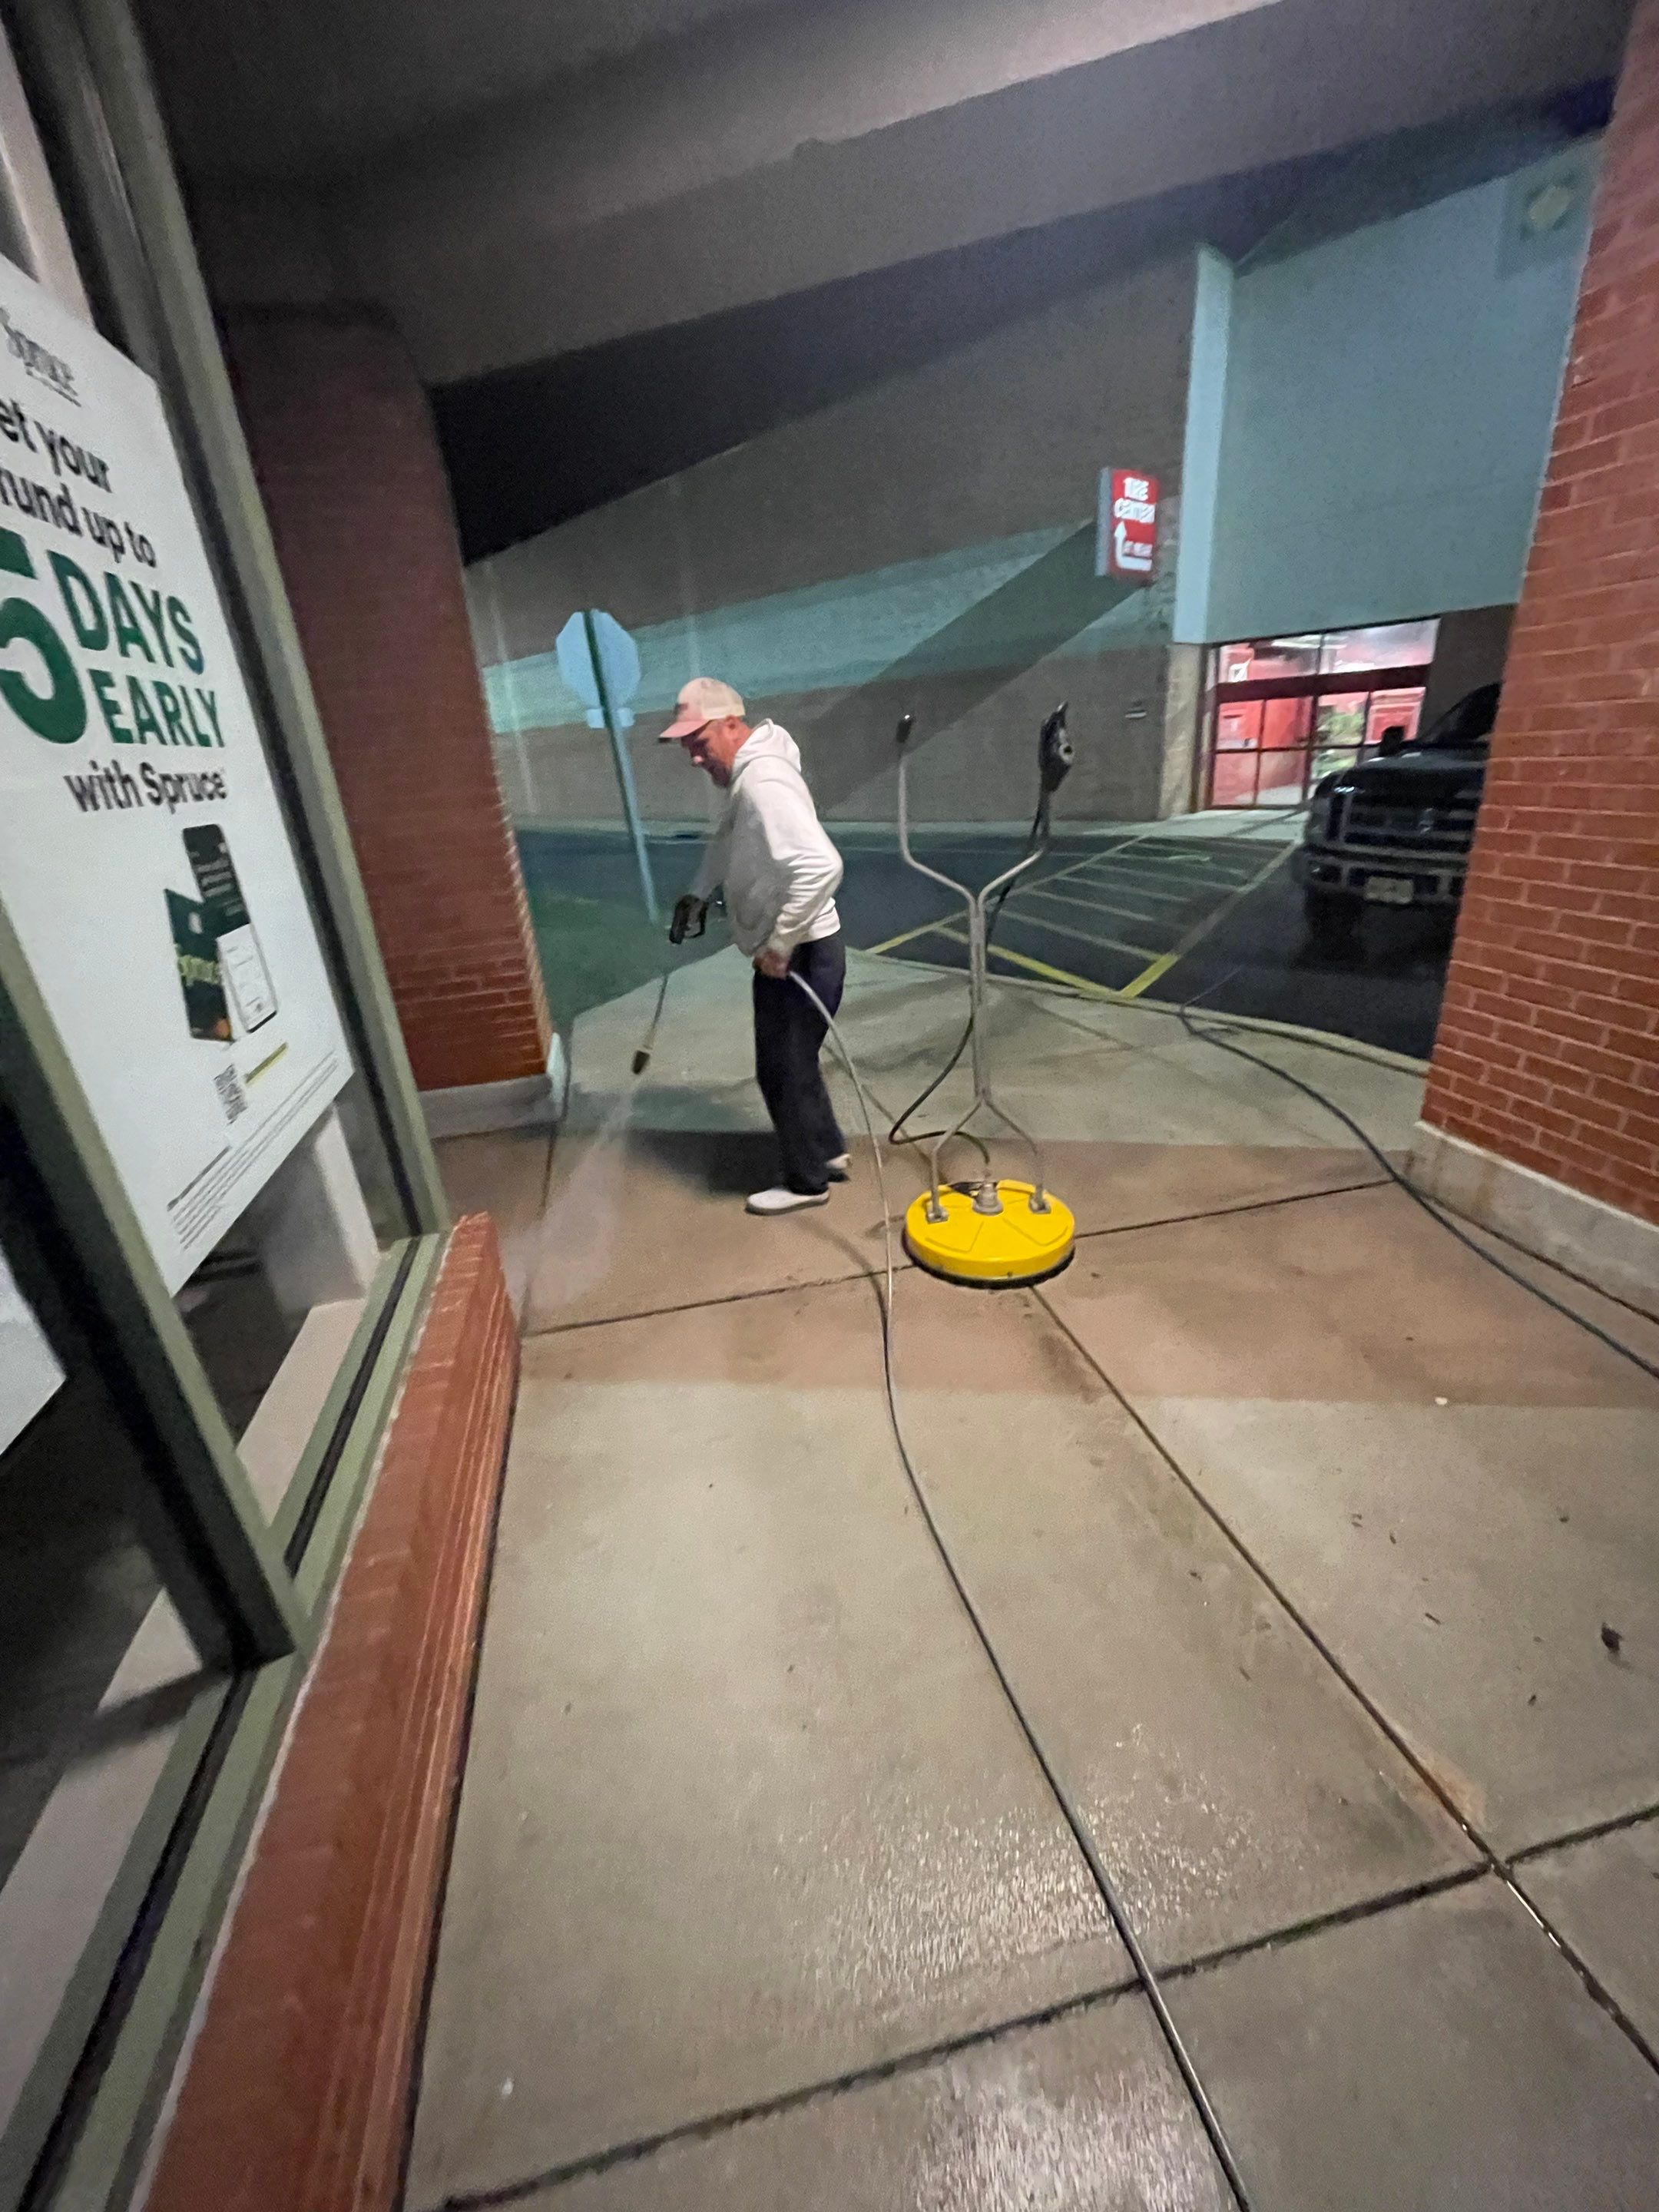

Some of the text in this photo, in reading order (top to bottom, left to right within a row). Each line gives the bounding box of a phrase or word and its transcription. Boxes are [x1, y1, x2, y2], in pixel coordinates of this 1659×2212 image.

[34, 420, 112, 493] your
[81, 506, 125, 563] up
[124, 521, 157, 568] to
[0, 526, 87, 744] 5
[46, 548, 204, 675] DAYS
[87, 668, 225, 748] EARLY
[63, 759, 227, 814] with Spruce
